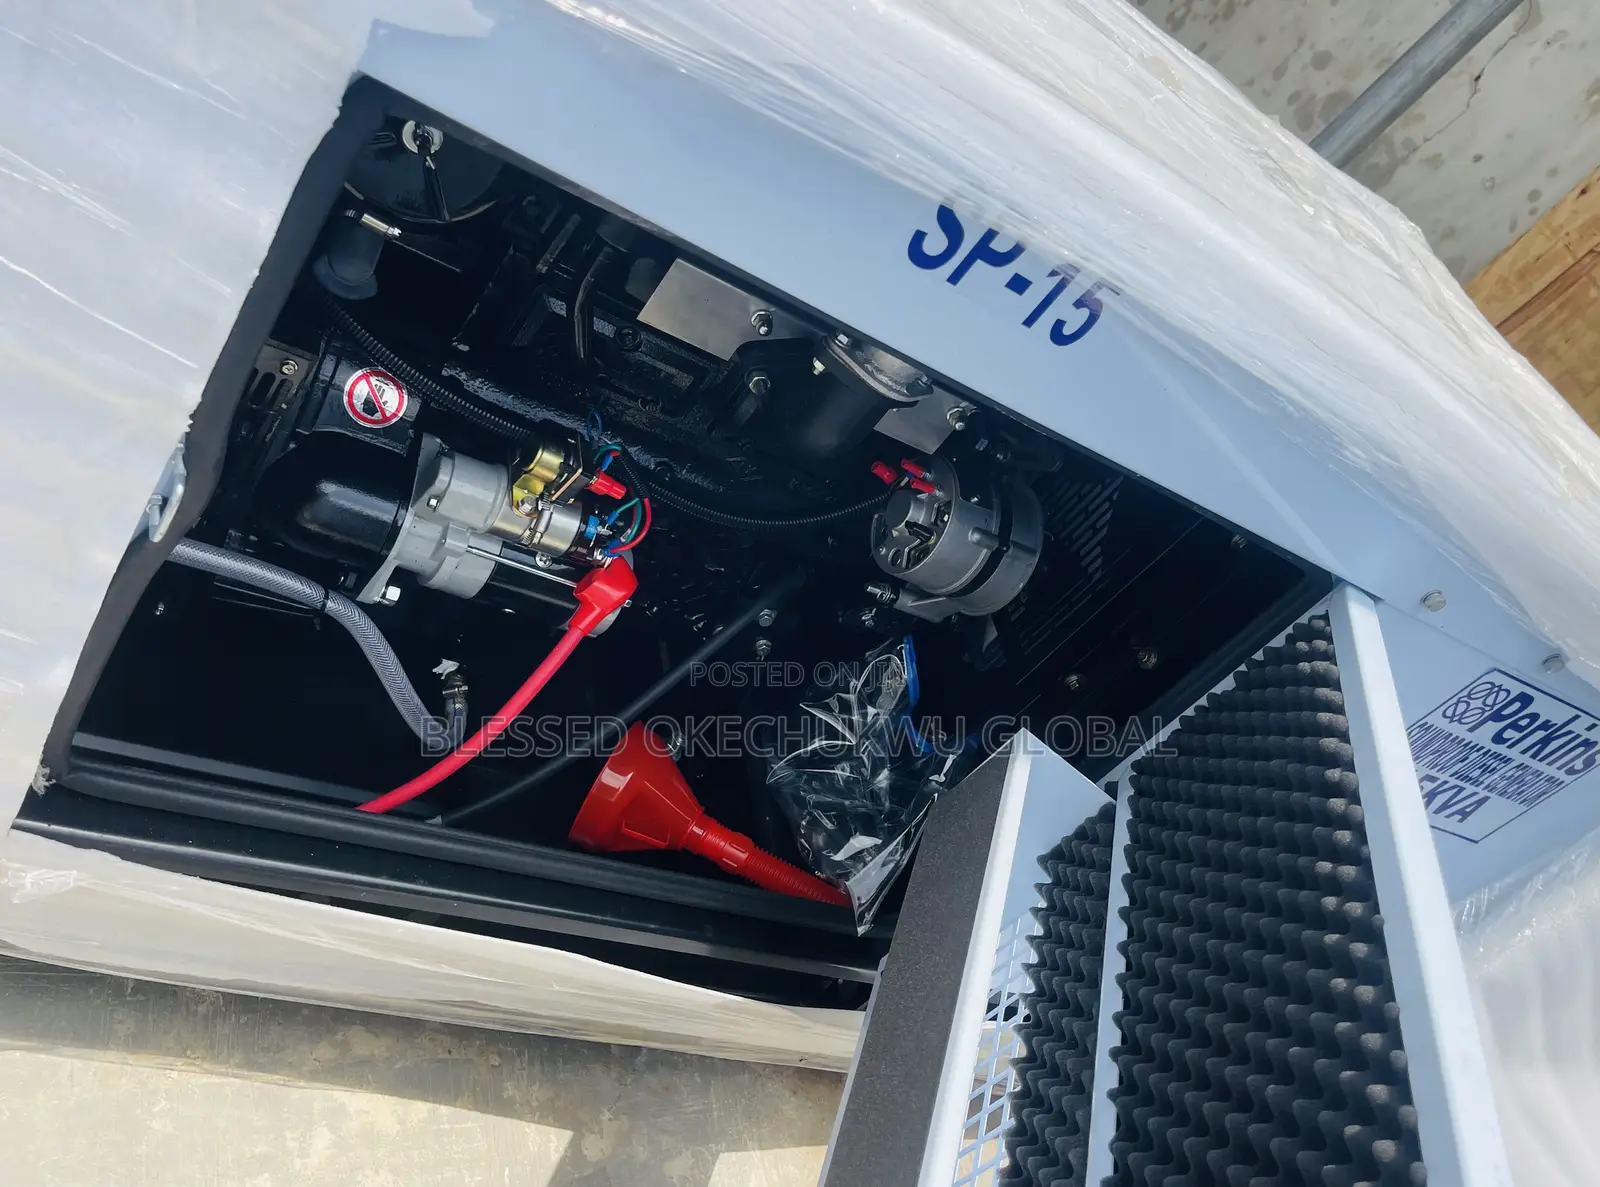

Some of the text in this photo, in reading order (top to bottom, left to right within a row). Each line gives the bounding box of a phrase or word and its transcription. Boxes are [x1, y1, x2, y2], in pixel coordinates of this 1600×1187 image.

[908, 202, 1120, 347] SP-15
[1466, 691, 1600, 776] Perkins
[1448, 749, 1516, 787] DIESEL
[1482, 762, 1565, 808] GENERATOR
